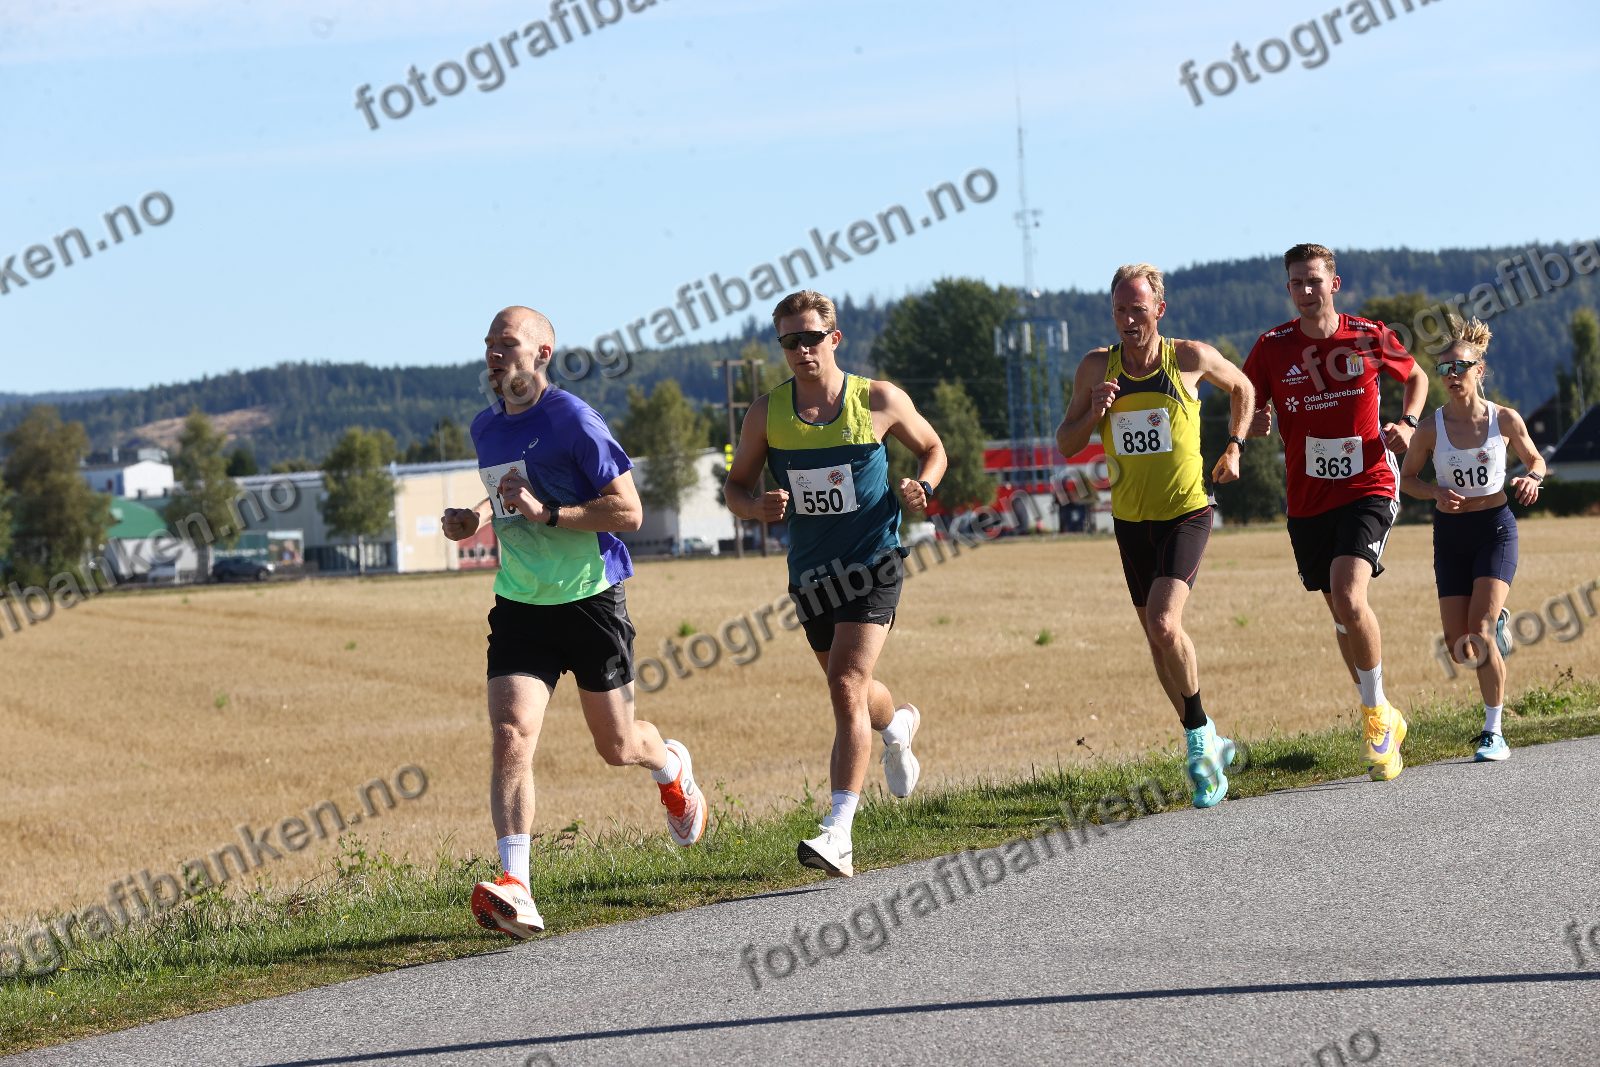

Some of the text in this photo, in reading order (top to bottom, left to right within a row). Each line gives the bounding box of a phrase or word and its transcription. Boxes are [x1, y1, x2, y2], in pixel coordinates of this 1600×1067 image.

[1303, 387, 1365, 405] Odal Sparebank
[1304, 400, 1339, 412] Gruppen
[1122, 428, 1161, 454] 838
[1315, 456, 1352, 478] 363
[1452, 465, 1489, 488] 818
[803, 487, 844, 514] 550
